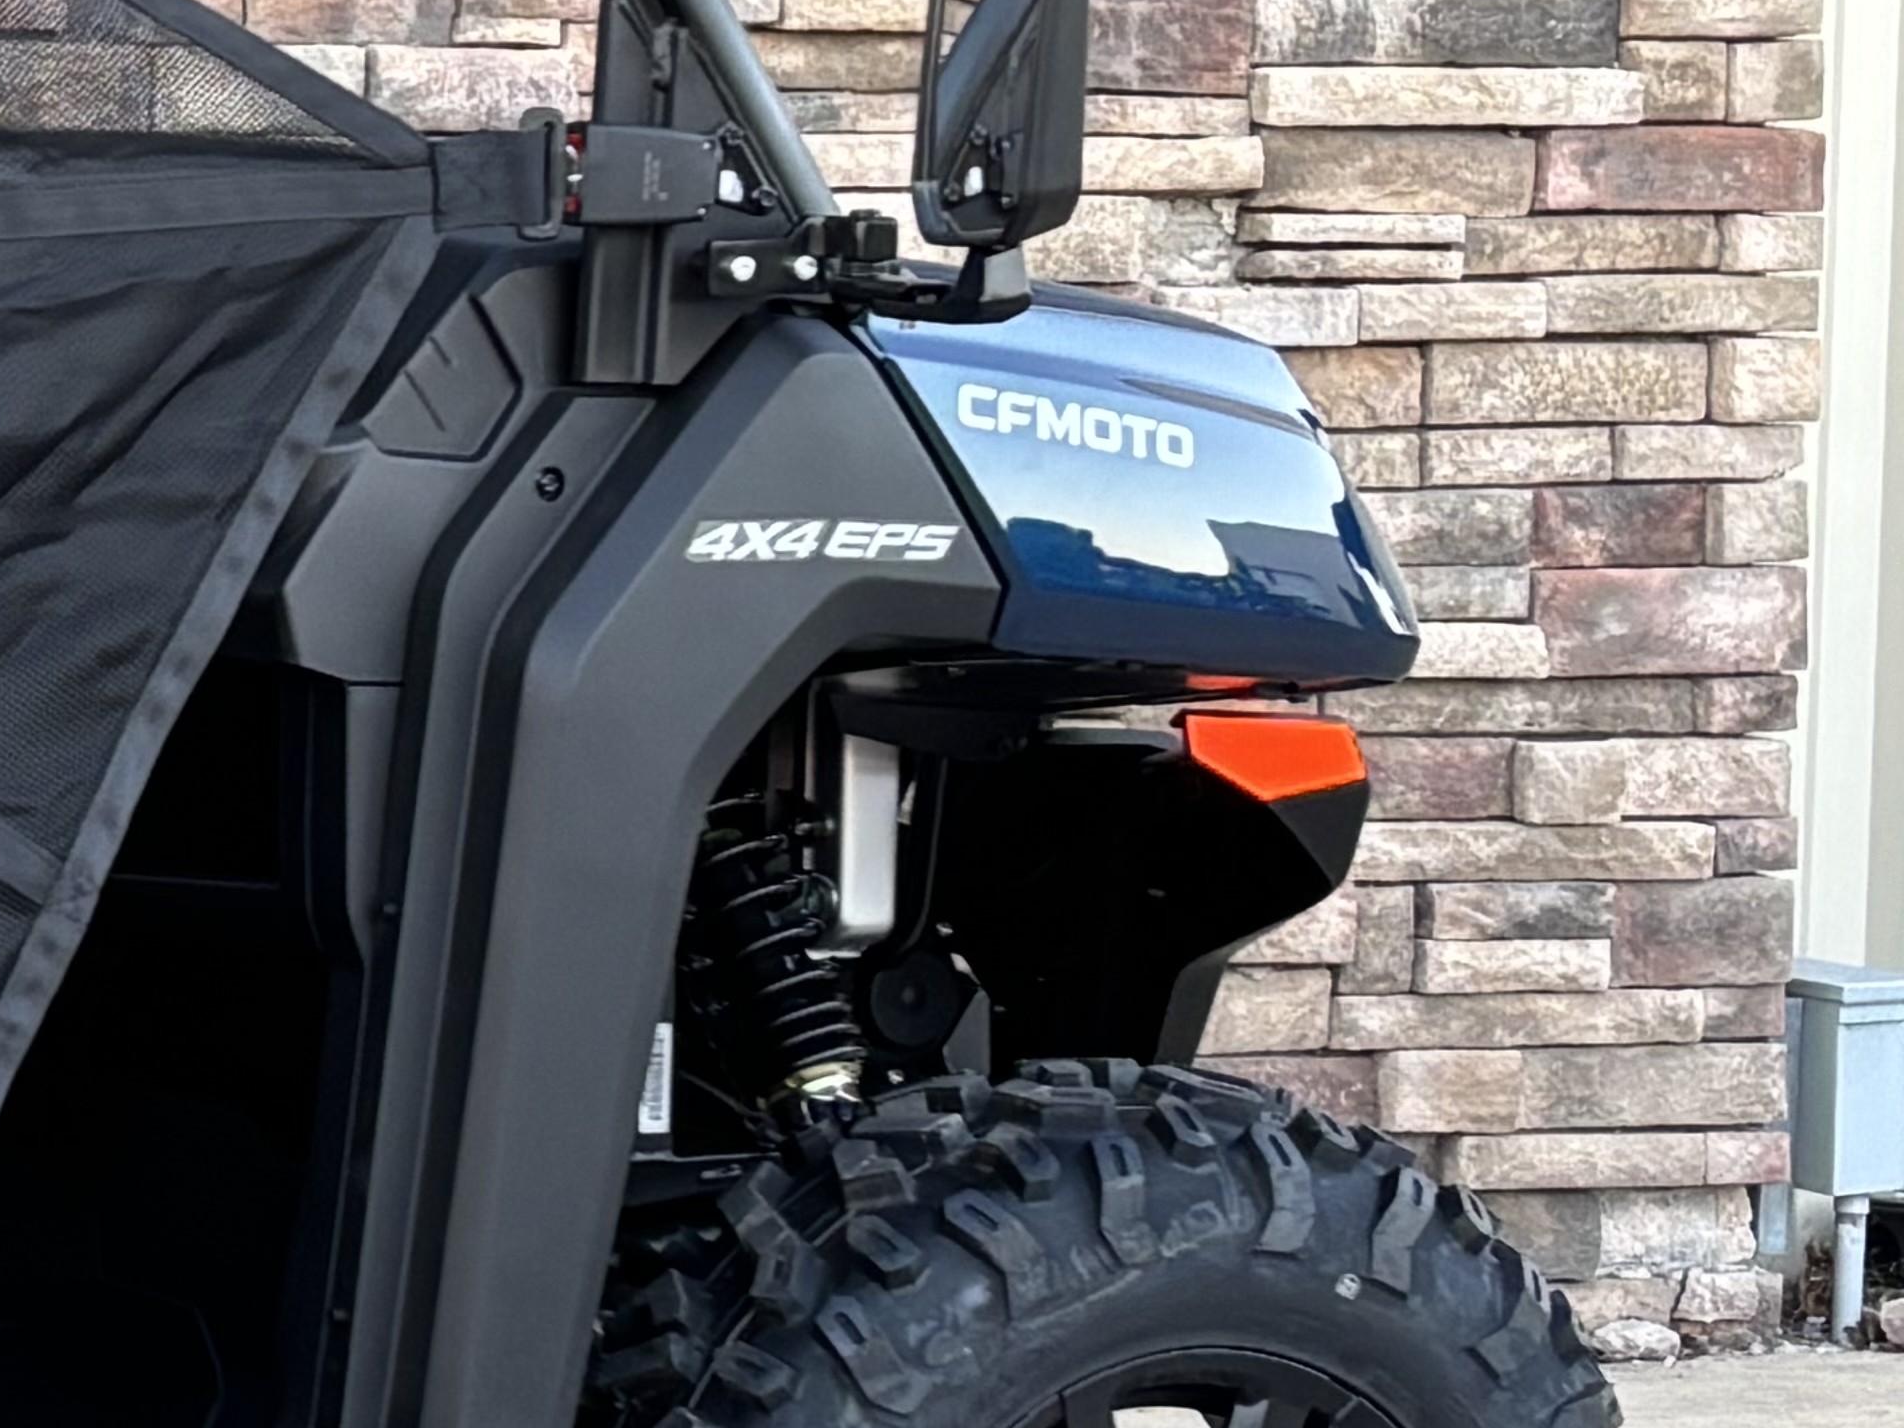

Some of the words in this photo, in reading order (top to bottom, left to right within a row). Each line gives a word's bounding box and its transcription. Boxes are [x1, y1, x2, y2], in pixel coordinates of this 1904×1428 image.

[957, 383, 1194, 469] CFMOTO
[687, 520, 826, 561] 4X4
[823, 520, 960, 561] EPS
